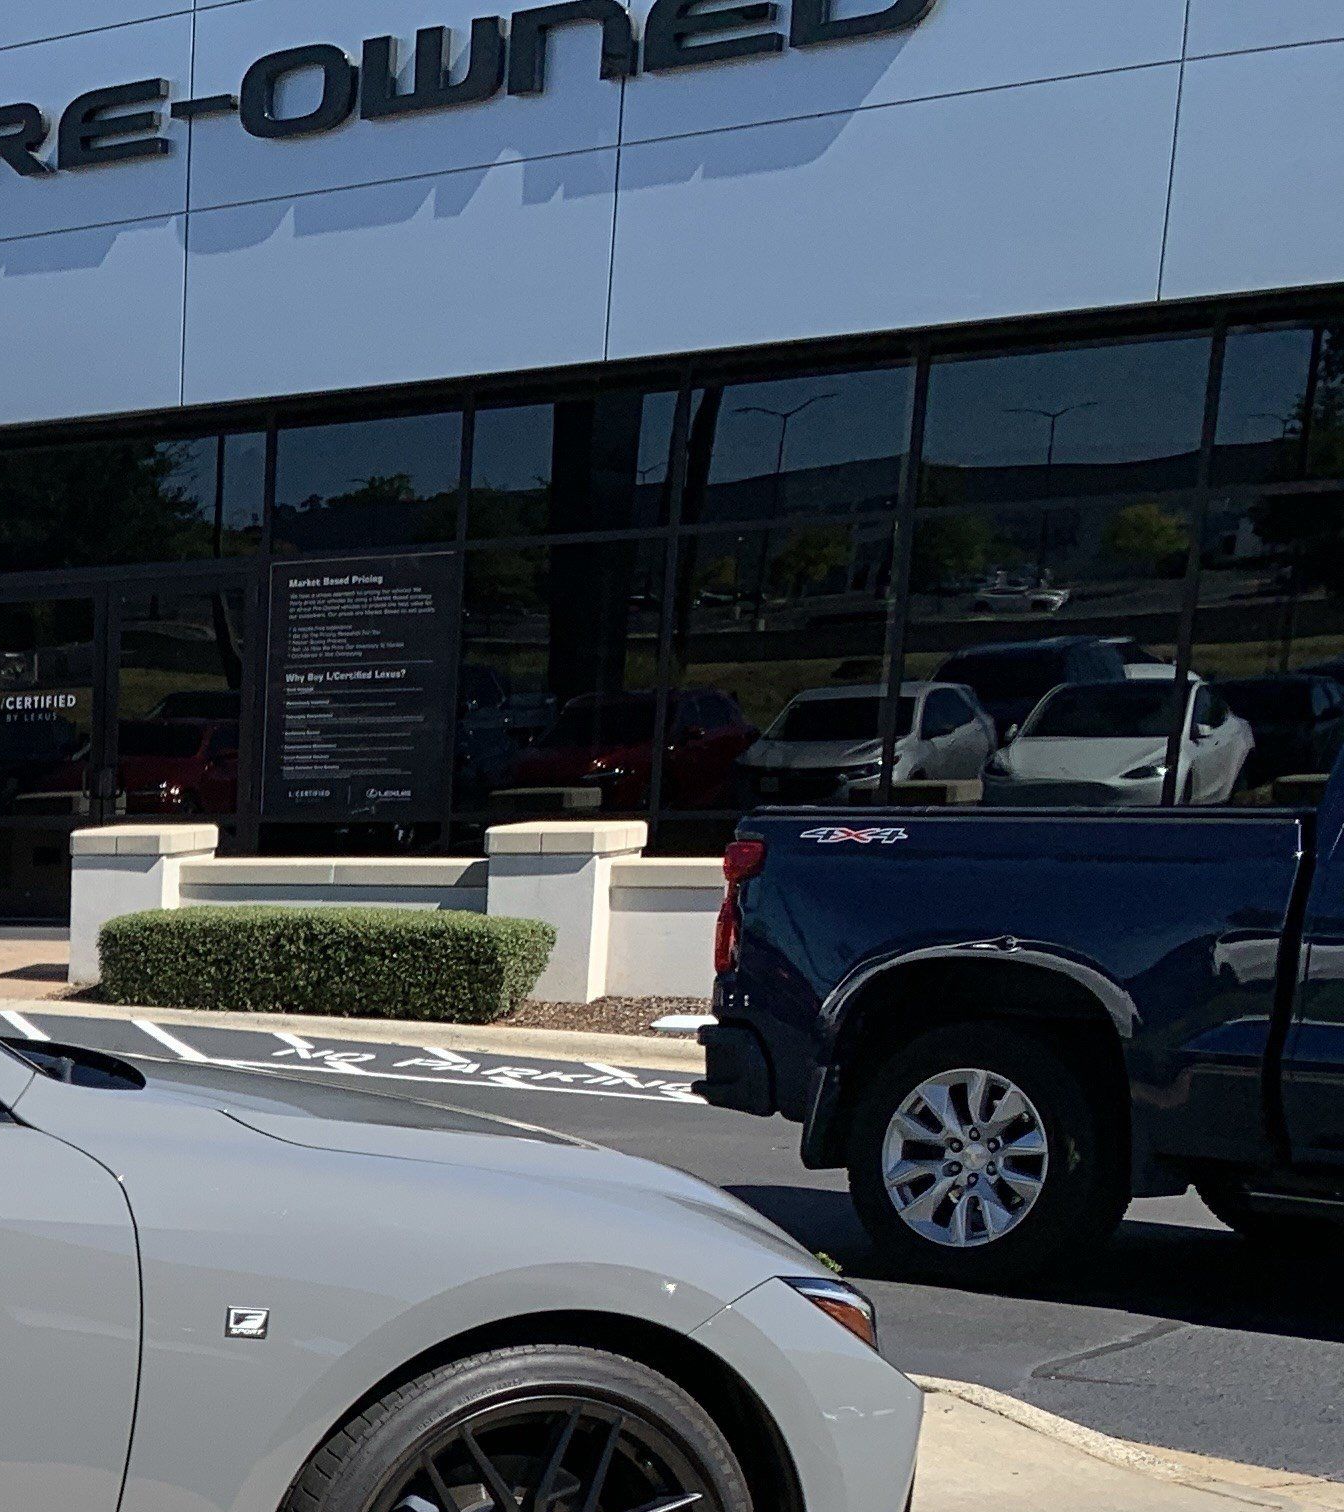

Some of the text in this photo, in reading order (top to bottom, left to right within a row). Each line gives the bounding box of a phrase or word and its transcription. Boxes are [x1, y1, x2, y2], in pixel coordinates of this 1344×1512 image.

[289, 575, 384, 588] Market Based Pricing
[24, 712, 58, 722] LEXUS
[271, 1047, 377, 1063] NO
